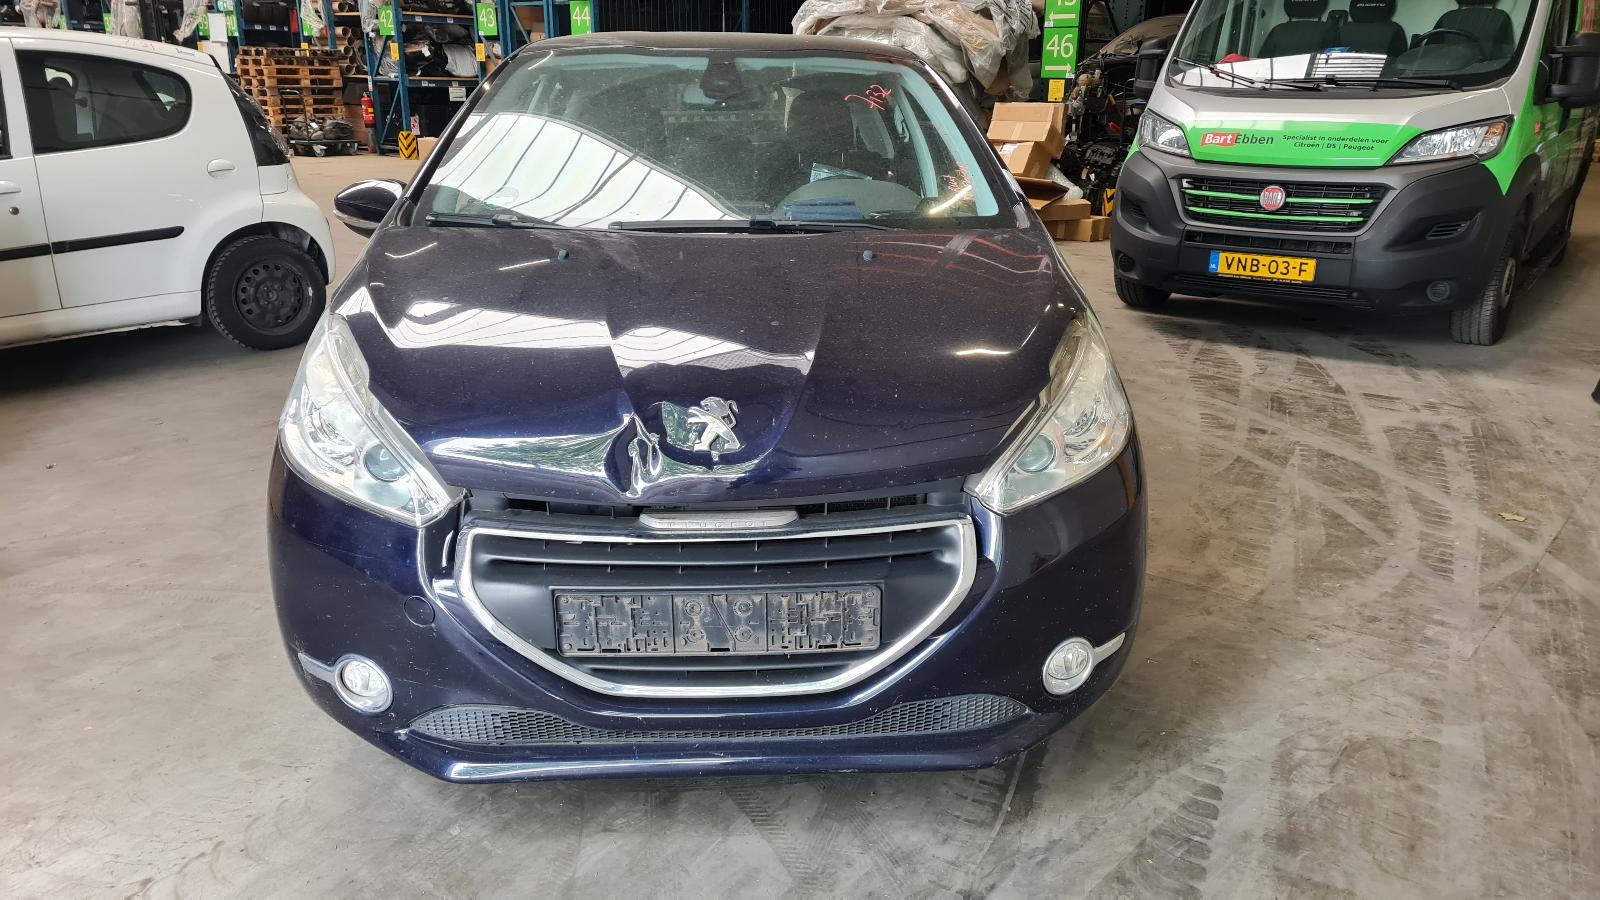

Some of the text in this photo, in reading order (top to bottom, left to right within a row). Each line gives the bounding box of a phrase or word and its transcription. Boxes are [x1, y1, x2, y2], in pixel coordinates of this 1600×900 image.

[380, 9, 394, 28] 42
[480, 8, 495, 27] 43
[572, 6, 591, 26] 44
[1046, 33, 1074, 58] 46
[1282, 134, 1317, 142] Specialist
[1343, 143, 1375, 151] Peugeot
[1225, 256, 1308, 277] VNB-03-F
